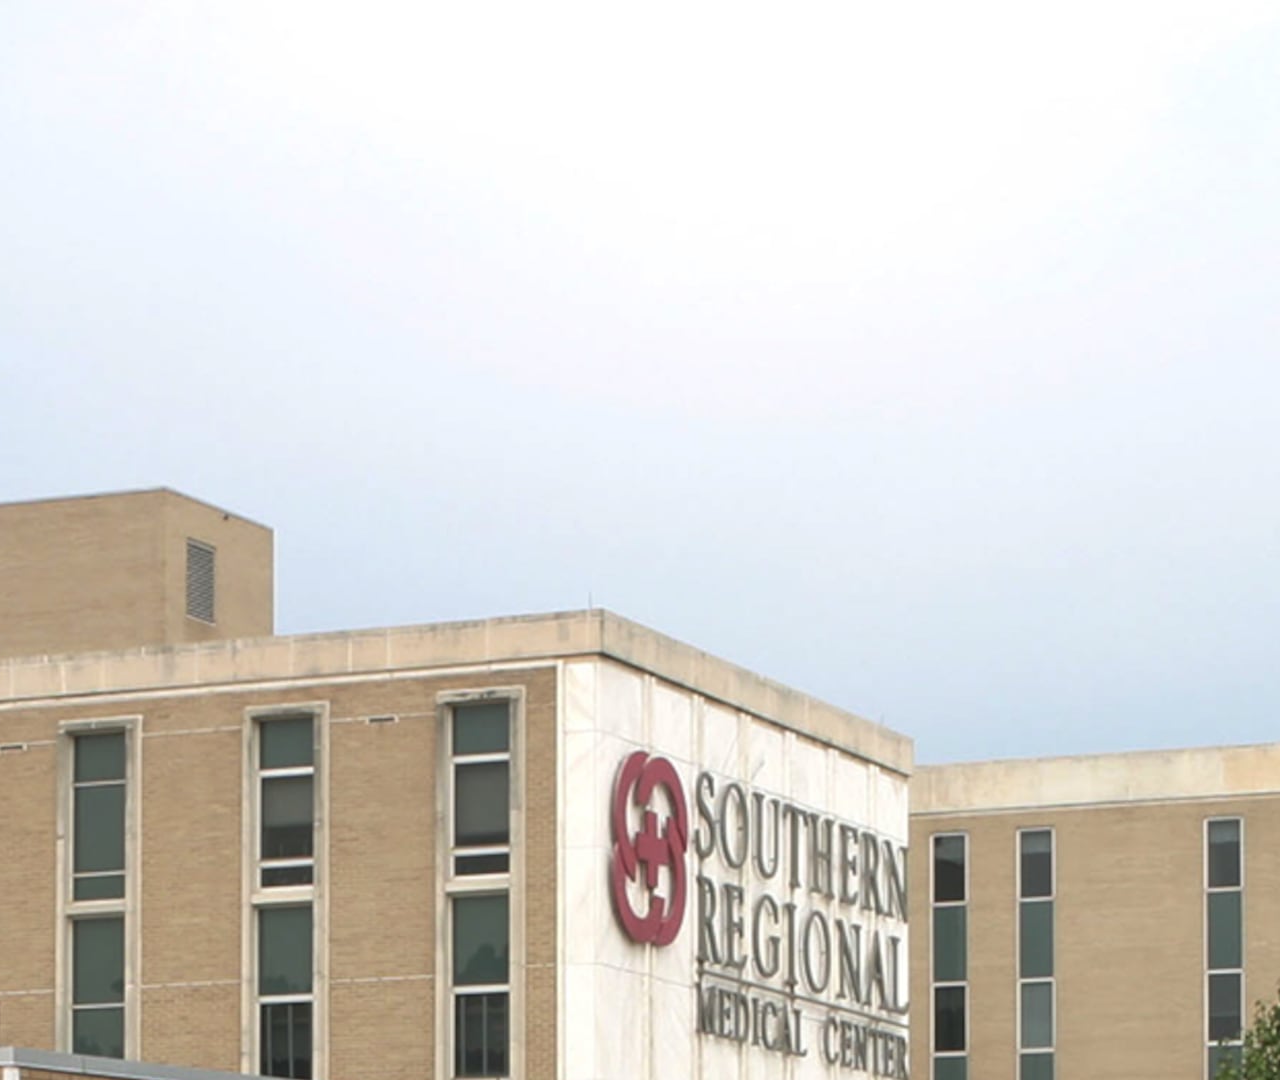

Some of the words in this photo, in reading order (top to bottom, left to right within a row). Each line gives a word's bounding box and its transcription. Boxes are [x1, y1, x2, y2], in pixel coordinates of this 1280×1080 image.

[694, 771, 909, 924] SOUTHERN
[696, 874, 909, 1015] REGIONAL
[696, 982, 808, 1058] MEDICAL
